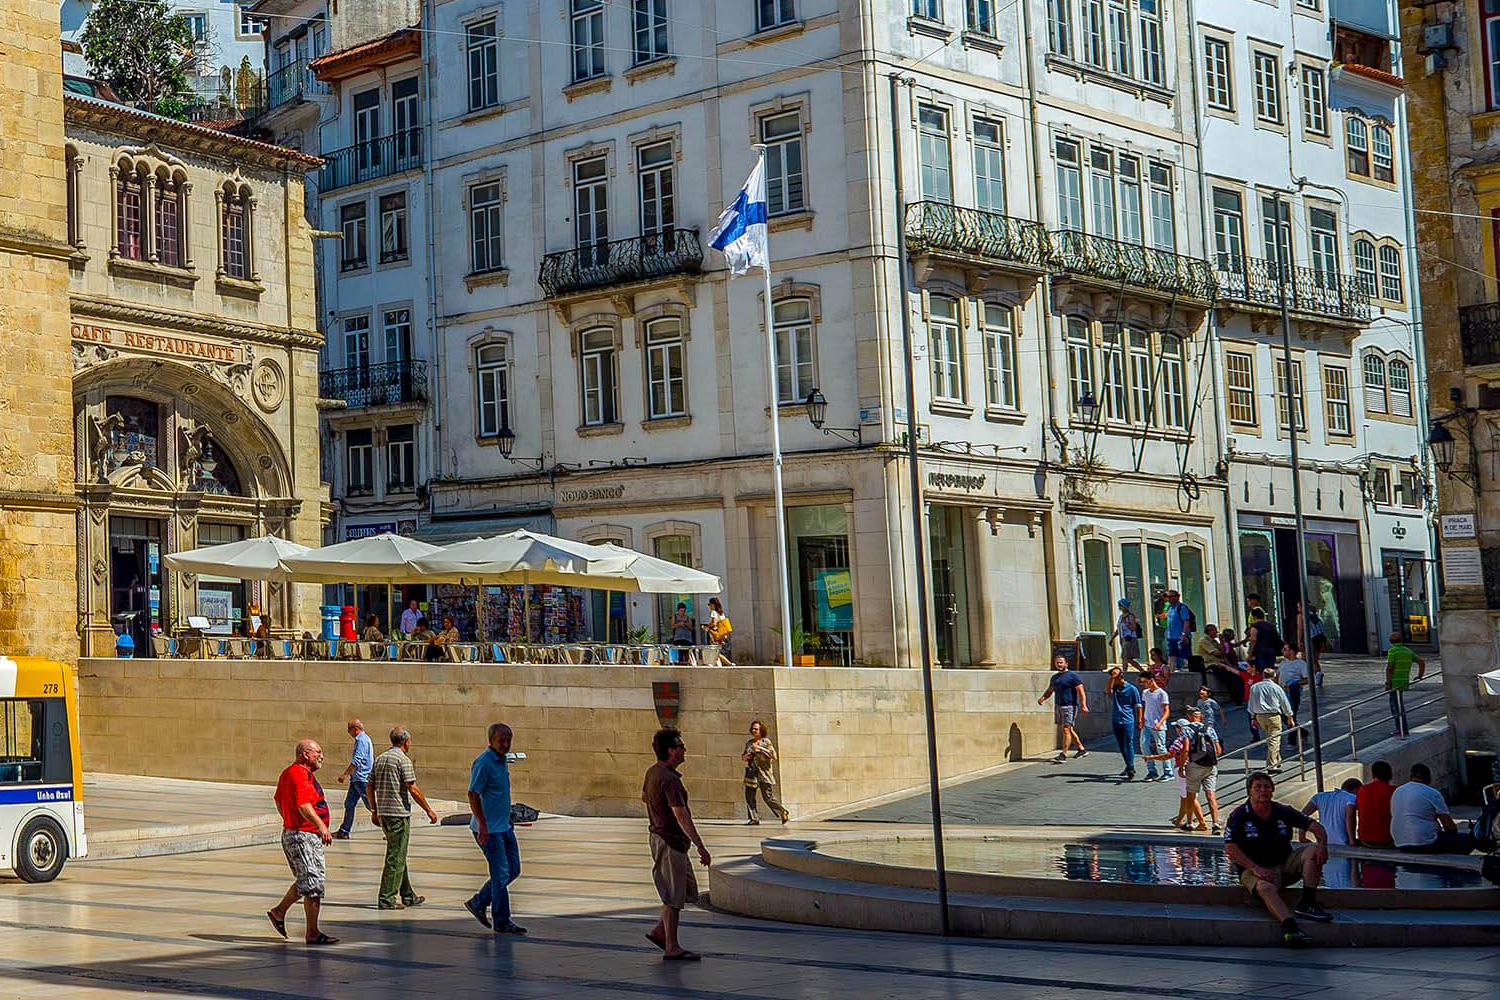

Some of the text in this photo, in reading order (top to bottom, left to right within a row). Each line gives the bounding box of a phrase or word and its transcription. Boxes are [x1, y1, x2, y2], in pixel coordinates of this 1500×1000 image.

[124, 332, 235, 360] RESTAURANTE
[561, 487, 623, 502] NOVO BANCO
[43, 683, 59, 694] 278
